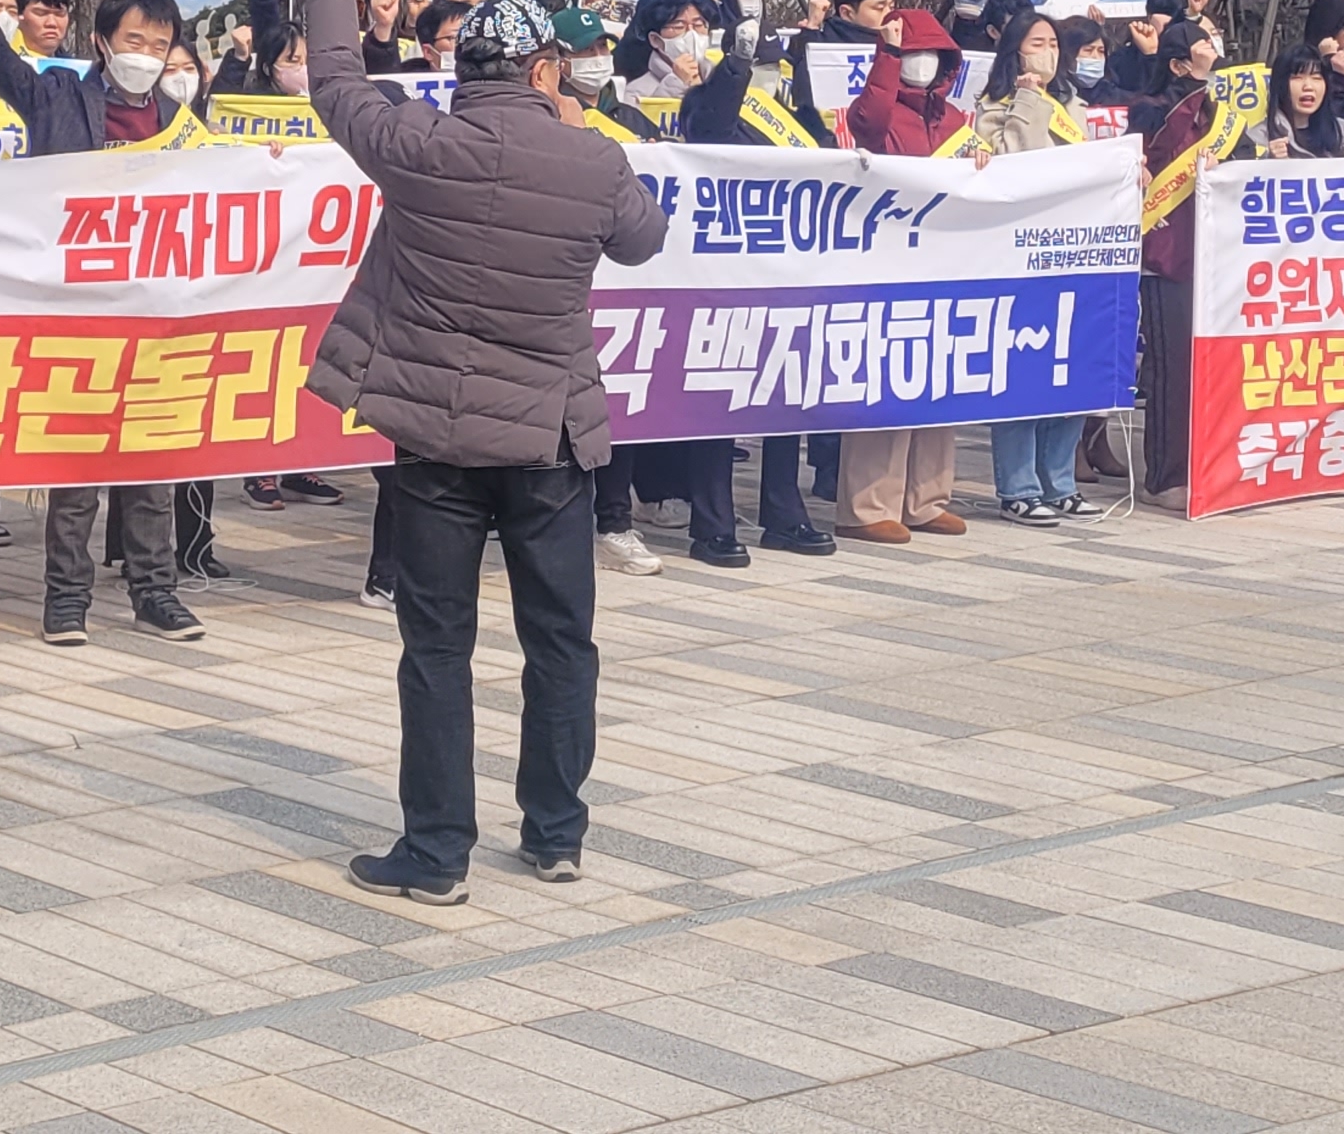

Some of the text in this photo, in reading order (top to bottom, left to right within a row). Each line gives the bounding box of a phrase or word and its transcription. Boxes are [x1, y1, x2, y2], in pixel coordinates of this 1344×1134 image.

[580, 13, 593, 26] C
[56, 183, 383, 284] 짬짜미 의
[691, 176, 948, 255] 웬말이냐~!
[1014, 223, 1141, 247] 남산숲살리기시민연대
[1026, 247, 1141, 270] 서울학부모단체연대
[591, 291, 1076, 416] 각 백지화하라~!
[1236, 418, 1320, 486] 즉각
